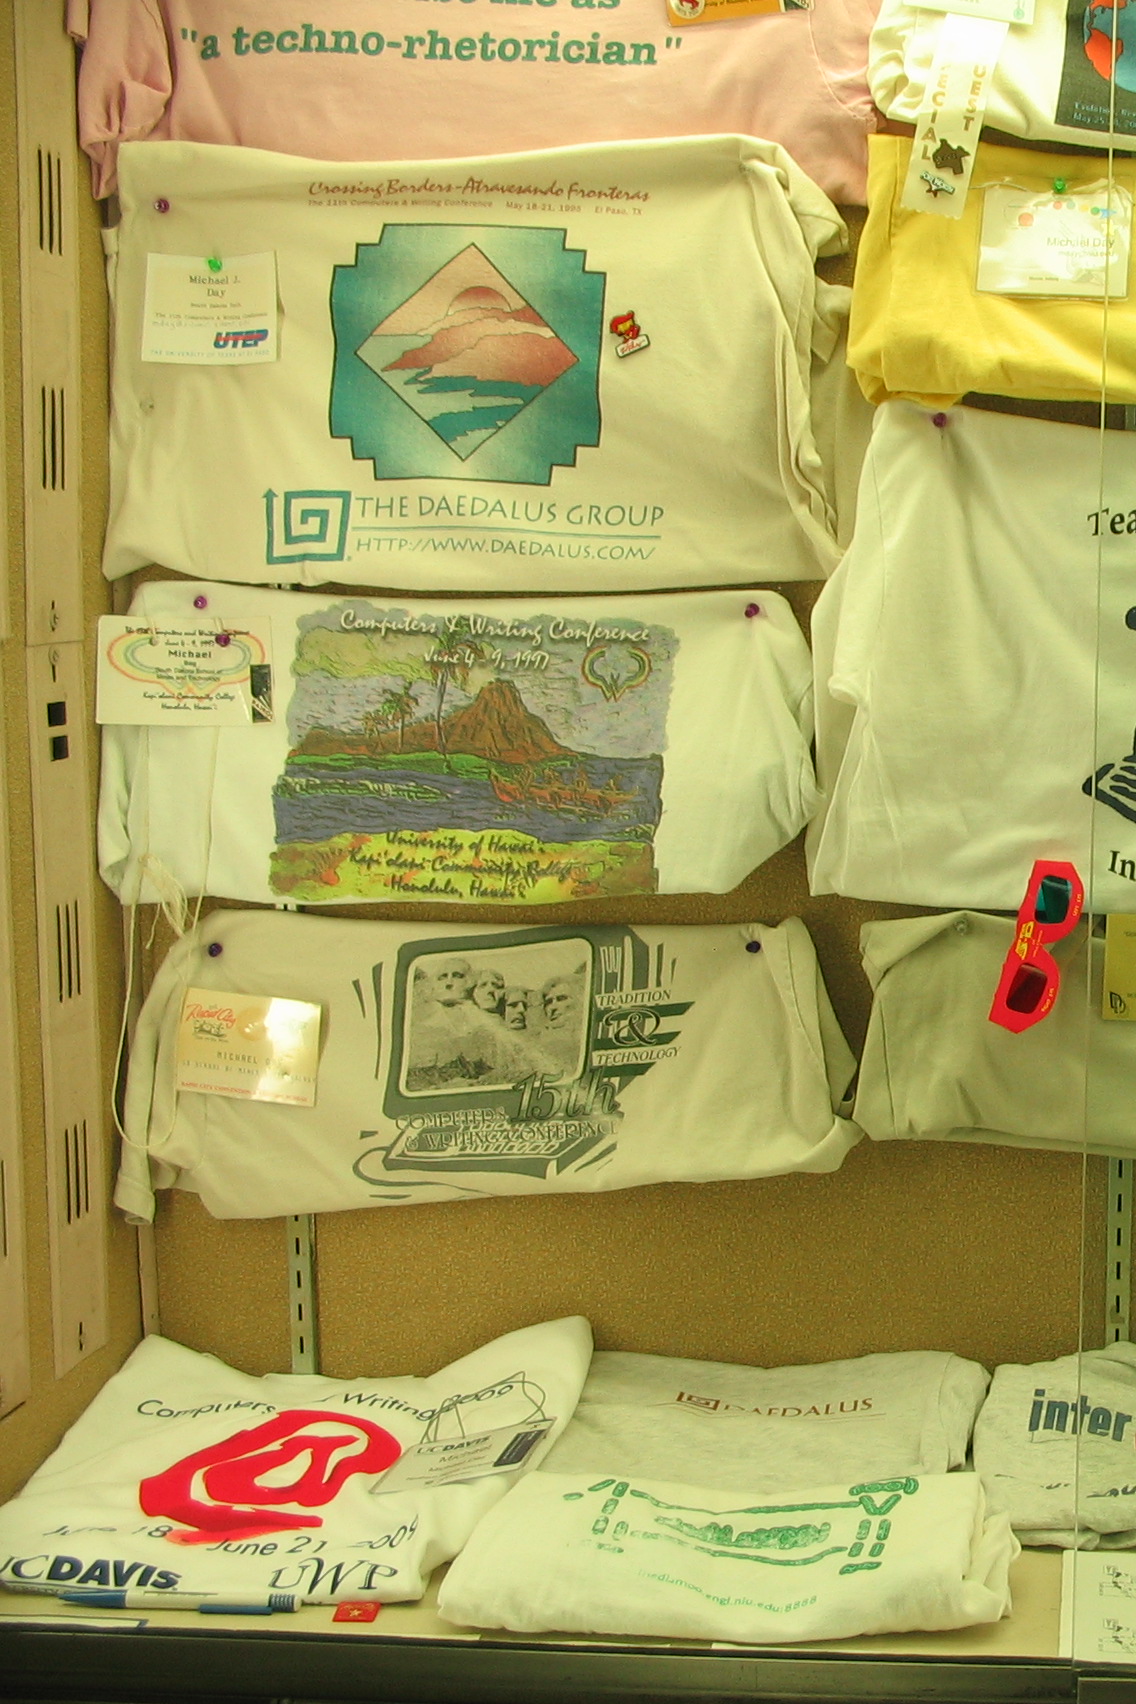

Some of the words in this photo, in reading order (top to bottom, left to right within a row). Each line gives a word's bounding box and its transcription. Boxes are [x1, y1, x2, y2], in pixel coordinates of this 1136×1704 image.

[181, 28, 220, 60] "a
[232, 23, 683, 65] techno-rhetorician"
[309, 180, 384, 200] Crossing
[566, 182, 651, 202] Fronteras
[189, 275, 229, 285] Michael
[207, 288, 227, 299] Day
[213, 329, 269, 349] UTEP
[357, 496, 409, 518] THE
[418, 496, 557, 523] DAEDALUS
[567, 505, 665, 527] GROUP
[340, 608, 438, 636] Computers
[468, 614, 542, 648] Writing
[548, 617, 651, 649] Conference
[168, 650, 212, 659] Michael
[386, 830, 465, 855] University
[469, 836, 485, 858] of
[1108, 850, 1136, 882] In
[597, 989, 671, 1007] TRADITION
[602, 1007, 661, 1047] &
[596, 1046, 682, 1065] TECHNOLOGY
[511, 1067, 625, 1123] 15th
[395, 1107, 510, 1130] COMPUTERS
[424, 1130, 507, 1148] WRITING
[504, 1119, 619, 1143] CONFERENCE
[136, 1398, 277, 1419] Computers
[341, 1393, 443, 1422] Writing
[1028, 1388, 1133, 1442] inter
[206, 1537, 278, 1557] June
[285, 1535, 328, 1554] 21
[268, 1556, 399, 1596] UWP
